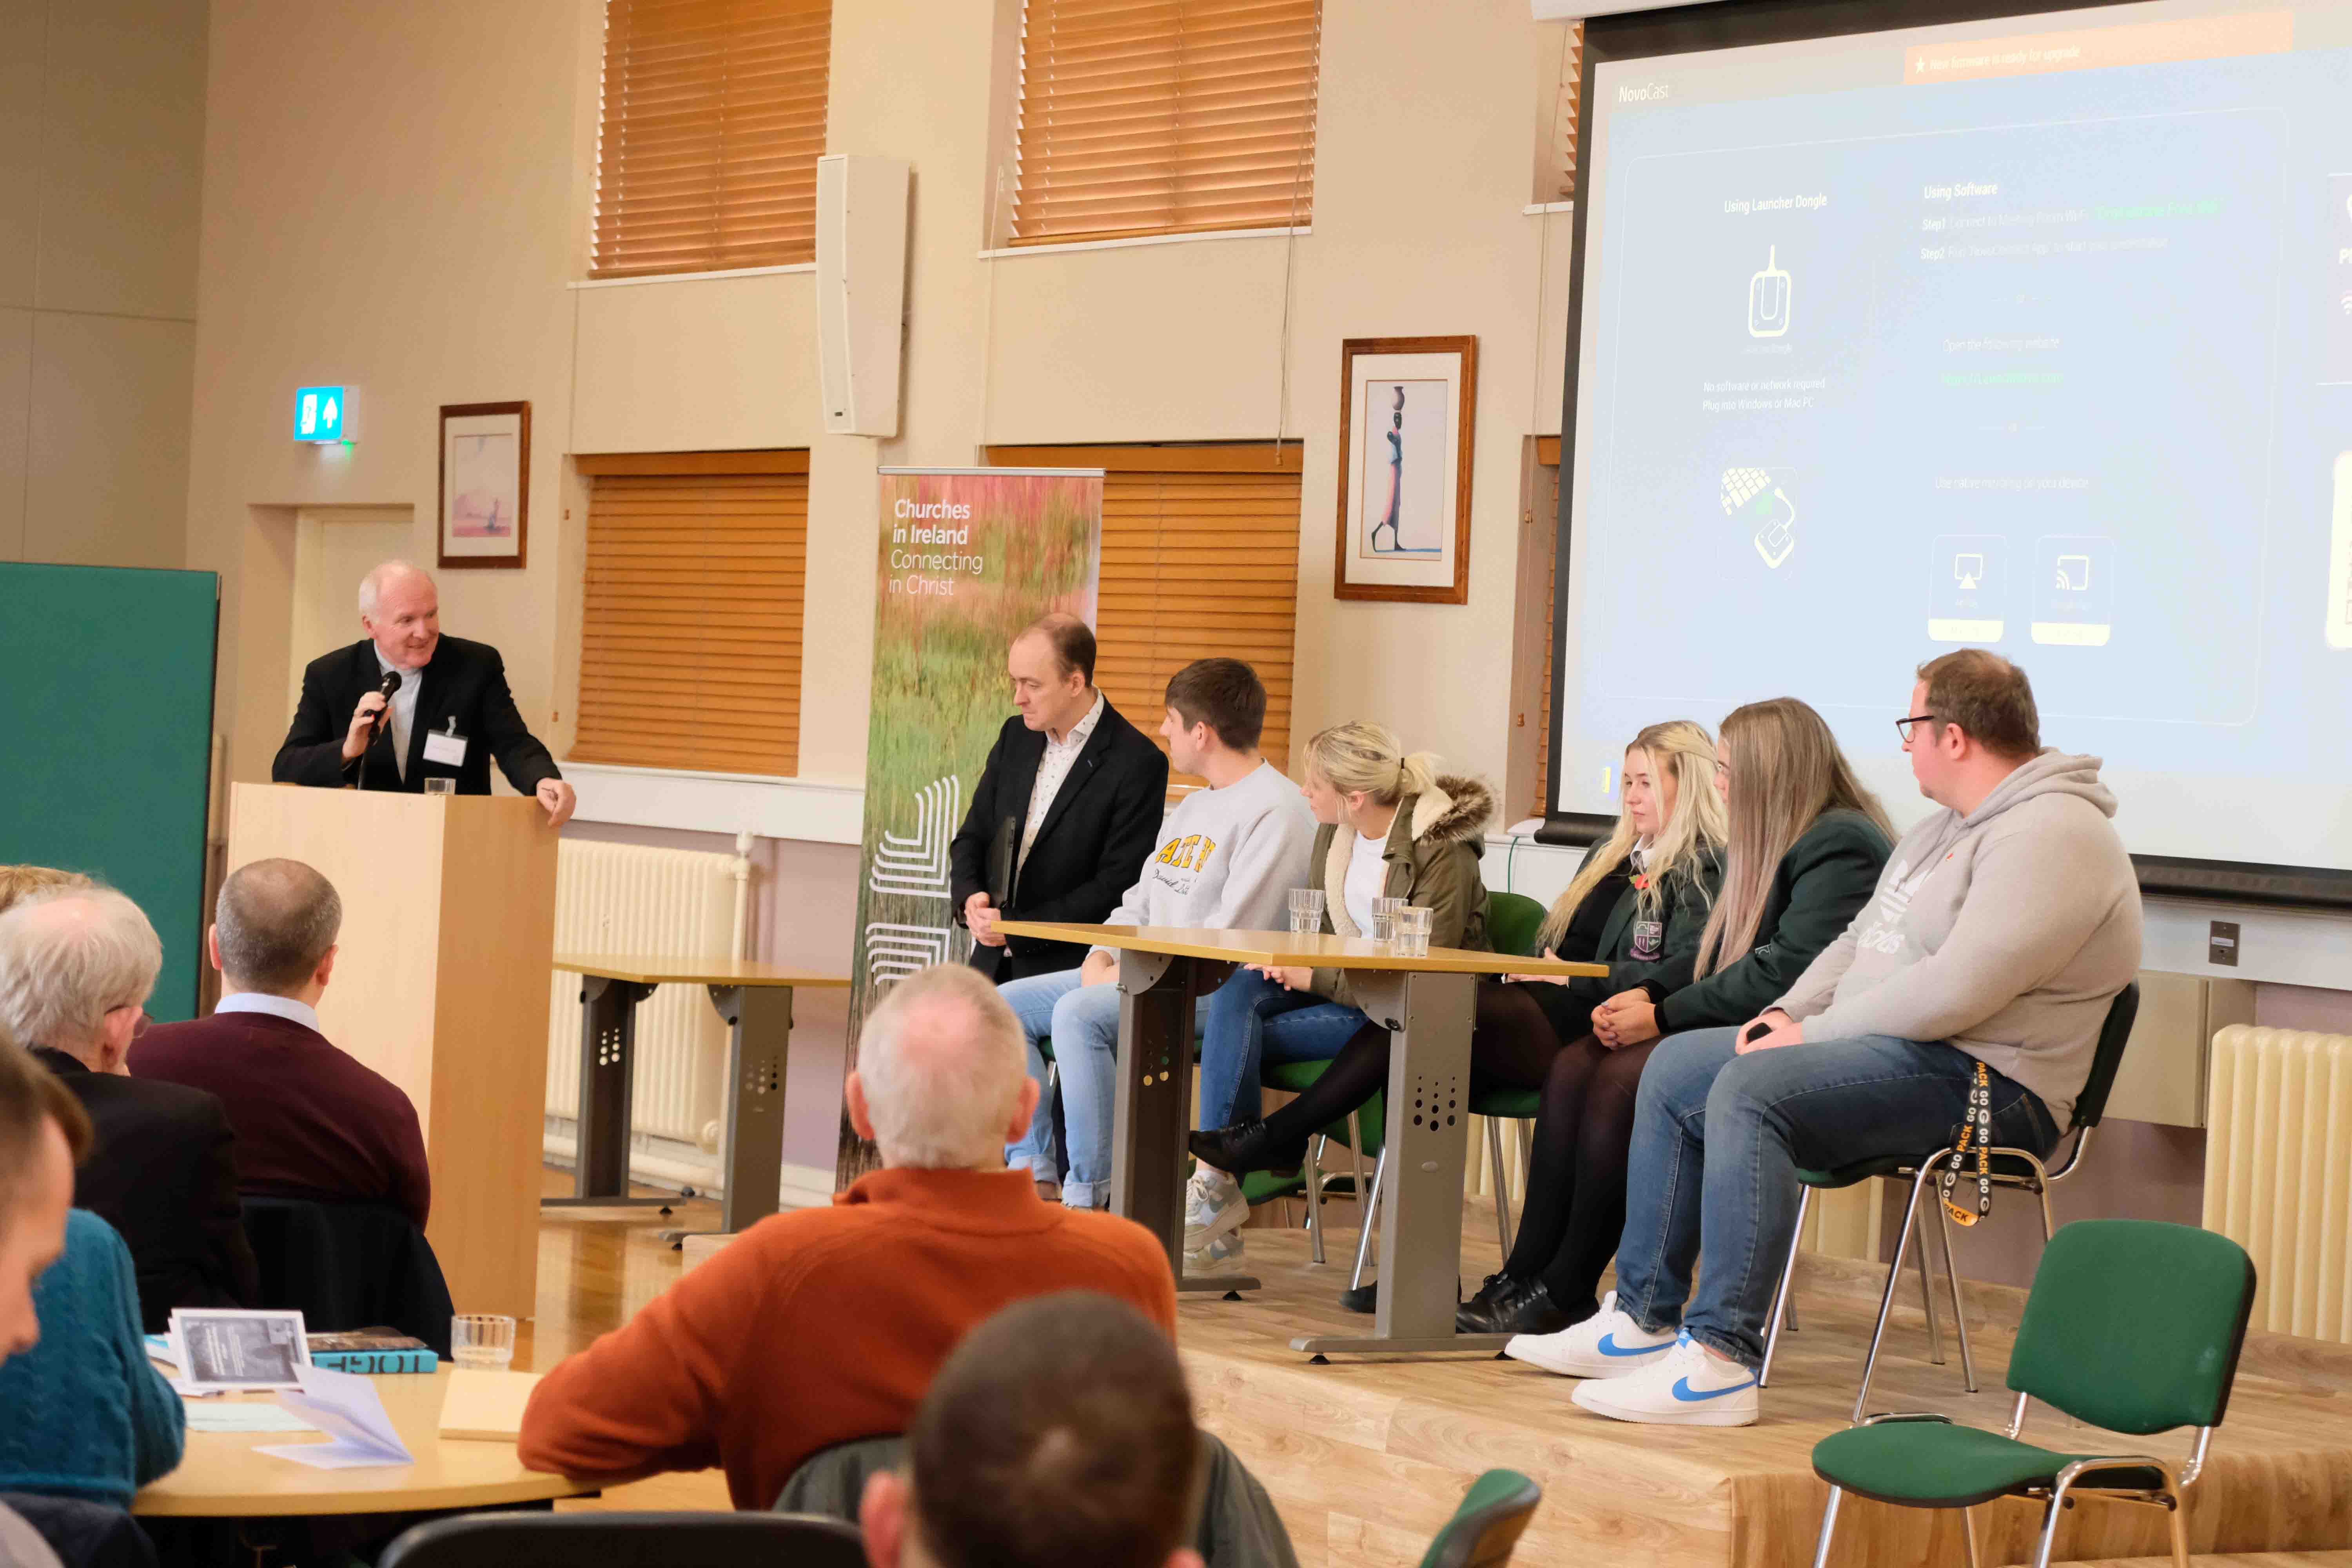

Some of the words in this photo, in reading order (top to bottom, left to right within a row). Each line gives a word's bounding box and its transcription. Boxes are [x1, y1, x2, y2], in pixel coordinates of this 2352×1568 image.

[1619, 83, 1669, 103] NovoCast
[1924, 185, 1951, 201] Using
[1953, 182, 1998, 196] Software
[1724, 199, 1750, 215] Using
[1752, 197, 1794, 211] Launcher
[1795, 192, 1827, 210] Dongle
[1922, 217, 1945, 232] Step1
[1921, 247, 1944, 261] Step2
[1704, 382, 1715, 392] No
[1716, 380, 1749, 392] software
[1760, 379, 1791, 390] network
[1794, 377, 1825, 392] required
[1702, 399, 1719, 412] Plug
[1737, 397, 1772, 410] Windows
[1784, 397, 1800, 408] Mac
[895, 499, 971, 519] Churches
[893, 524, 906, 544] in
[910, 524, 968, 544] Ireland
[891, 549, 983, 575] Connecting
[889, 574, 902, 593] in
[906, 575, 954, 595] Christ
[1976, 1062, 1988, 1087] PACK
[1979, 1090, 1989, 1106] GO
[1966, 1107, 1976, 1123] GO
[1956, 1124, 1973, 1152] PACK
[1979, 1128, 1988, 1143] GO
[1951, 1154, 1963, 1169] GO
[1979, 1147, 1989, 1175] PACK
[1980, 1178, 1989, 1194] GO
